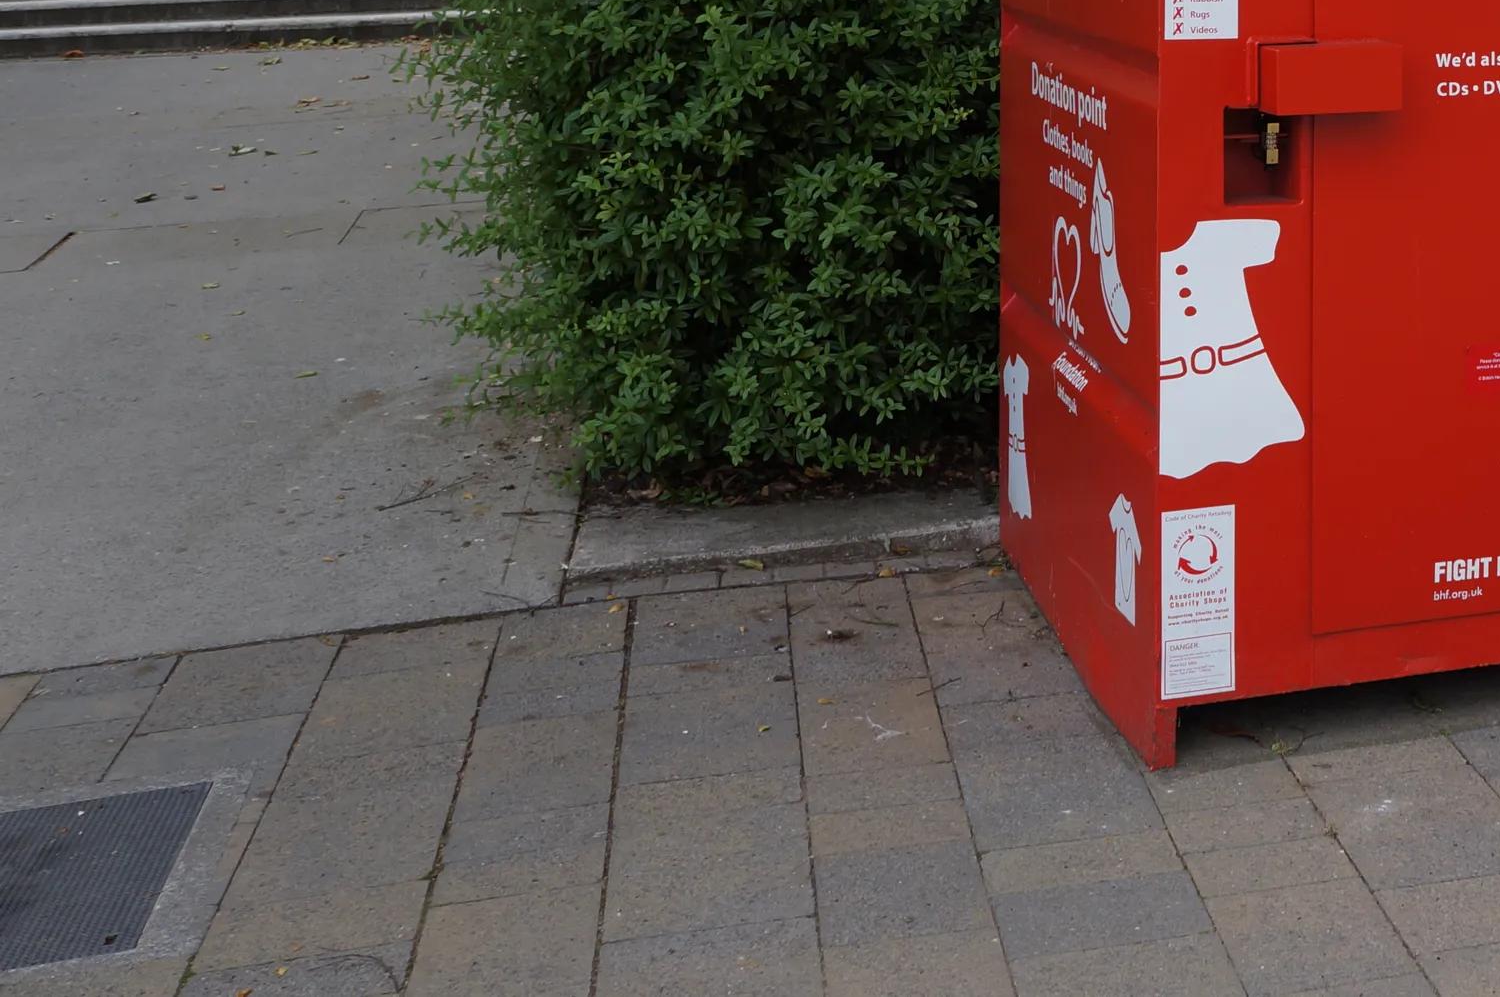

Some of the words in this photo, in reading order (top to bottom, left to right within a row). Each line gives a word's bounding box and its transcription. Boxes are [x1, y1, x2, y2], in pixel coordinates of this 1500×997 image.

[1190, 11, 1210, 19] Rugs
[1190, 26, 1217, 34] Videos
[1032, 62, 1075, 115] Donation
[1078, 92, 1107, 131] point
[1437, 82, 1469, 97] CDs
[1042, 120, 1071, 157] Clothes,
[1071, 134, 1093, 169] books
[1049, 166, 1063, 192] and
[1064, 174, 1086, 209] things
[1053, 351, 1088, 392] Foundation
[1434, 556, 1492, 583] FIGHT
[1169, 591, 1216, 601] Association
[1434, 587, 1482, 601] bhf.org.uk
[1170, 600, 1199, 609] Charity
[1204, 597, 1227, 605] Shops
[1170, 643, 1198, 651] DANGER
